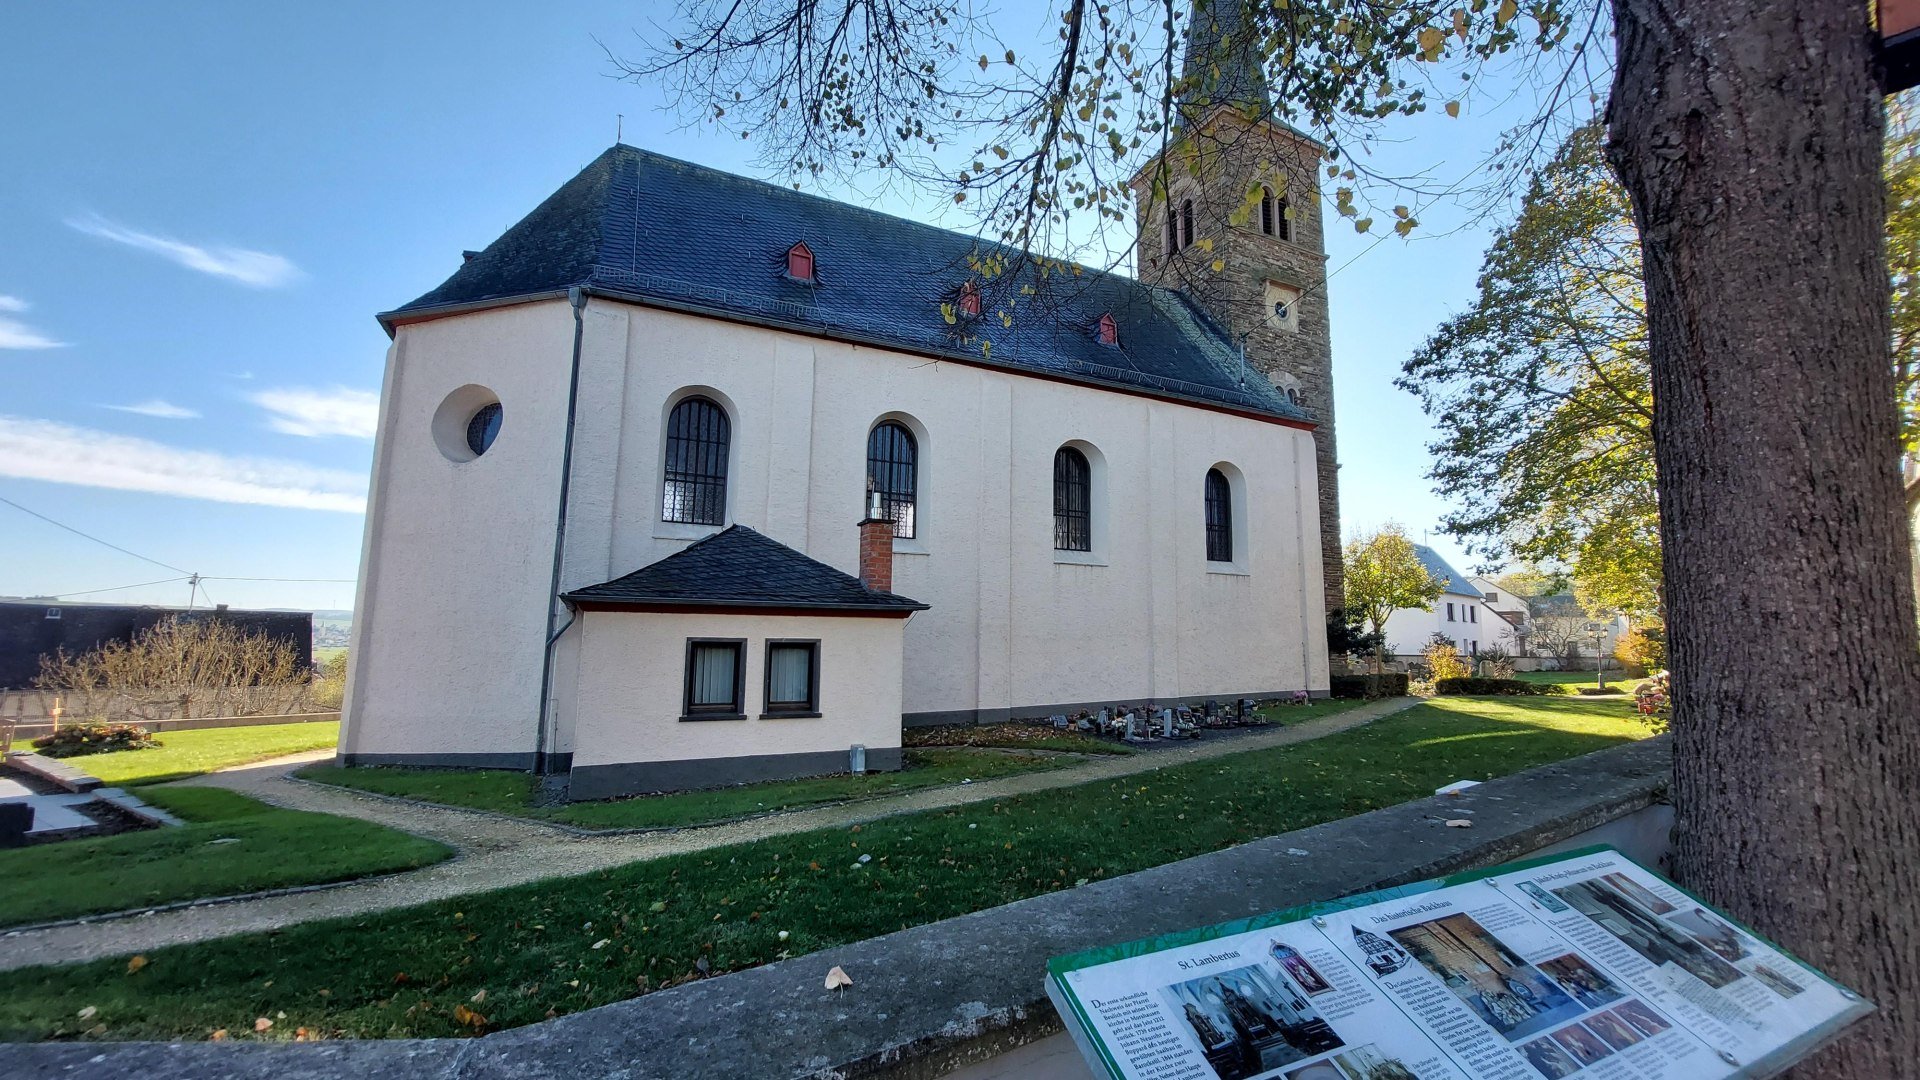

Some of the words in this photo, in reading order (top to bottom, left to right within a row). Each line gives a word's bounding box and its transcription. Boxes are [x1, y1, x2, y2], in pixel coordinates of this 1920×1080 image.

[1370, 916, 1388, 924] Das
[1384, 907, 1423, 920] historische
[1419, 901, 1452, 911] Backhaus
[1178, 961, 1193, 969] St.
[1191, 951, 1240, 966] Lambertus
[1091, 1000, 1106, 1008] Der
[1099, 1005, 1124, 1014] Nachweis
[1113, 1027, 1124, 1035] geht
[1120, 1040, 1140, 1049] Johann
[1125, 1045, 1148, 1055] Boppard
[1157, 1036, 1180, 1046] heutigen
[1130, 1052, 1156, 1063] gewölbten
[1155, 1046, 1175, 1054] Saalbau
[1132, 1058, 1162, 1070] Barockstil.
[1174, 1049, 1193, 1058] standen
[1155, 1064, 1174, 1072] Kirche
[1174, 1058, 1187, 1066] zwei
[1159, 1072, 1176, 1080] Neben
